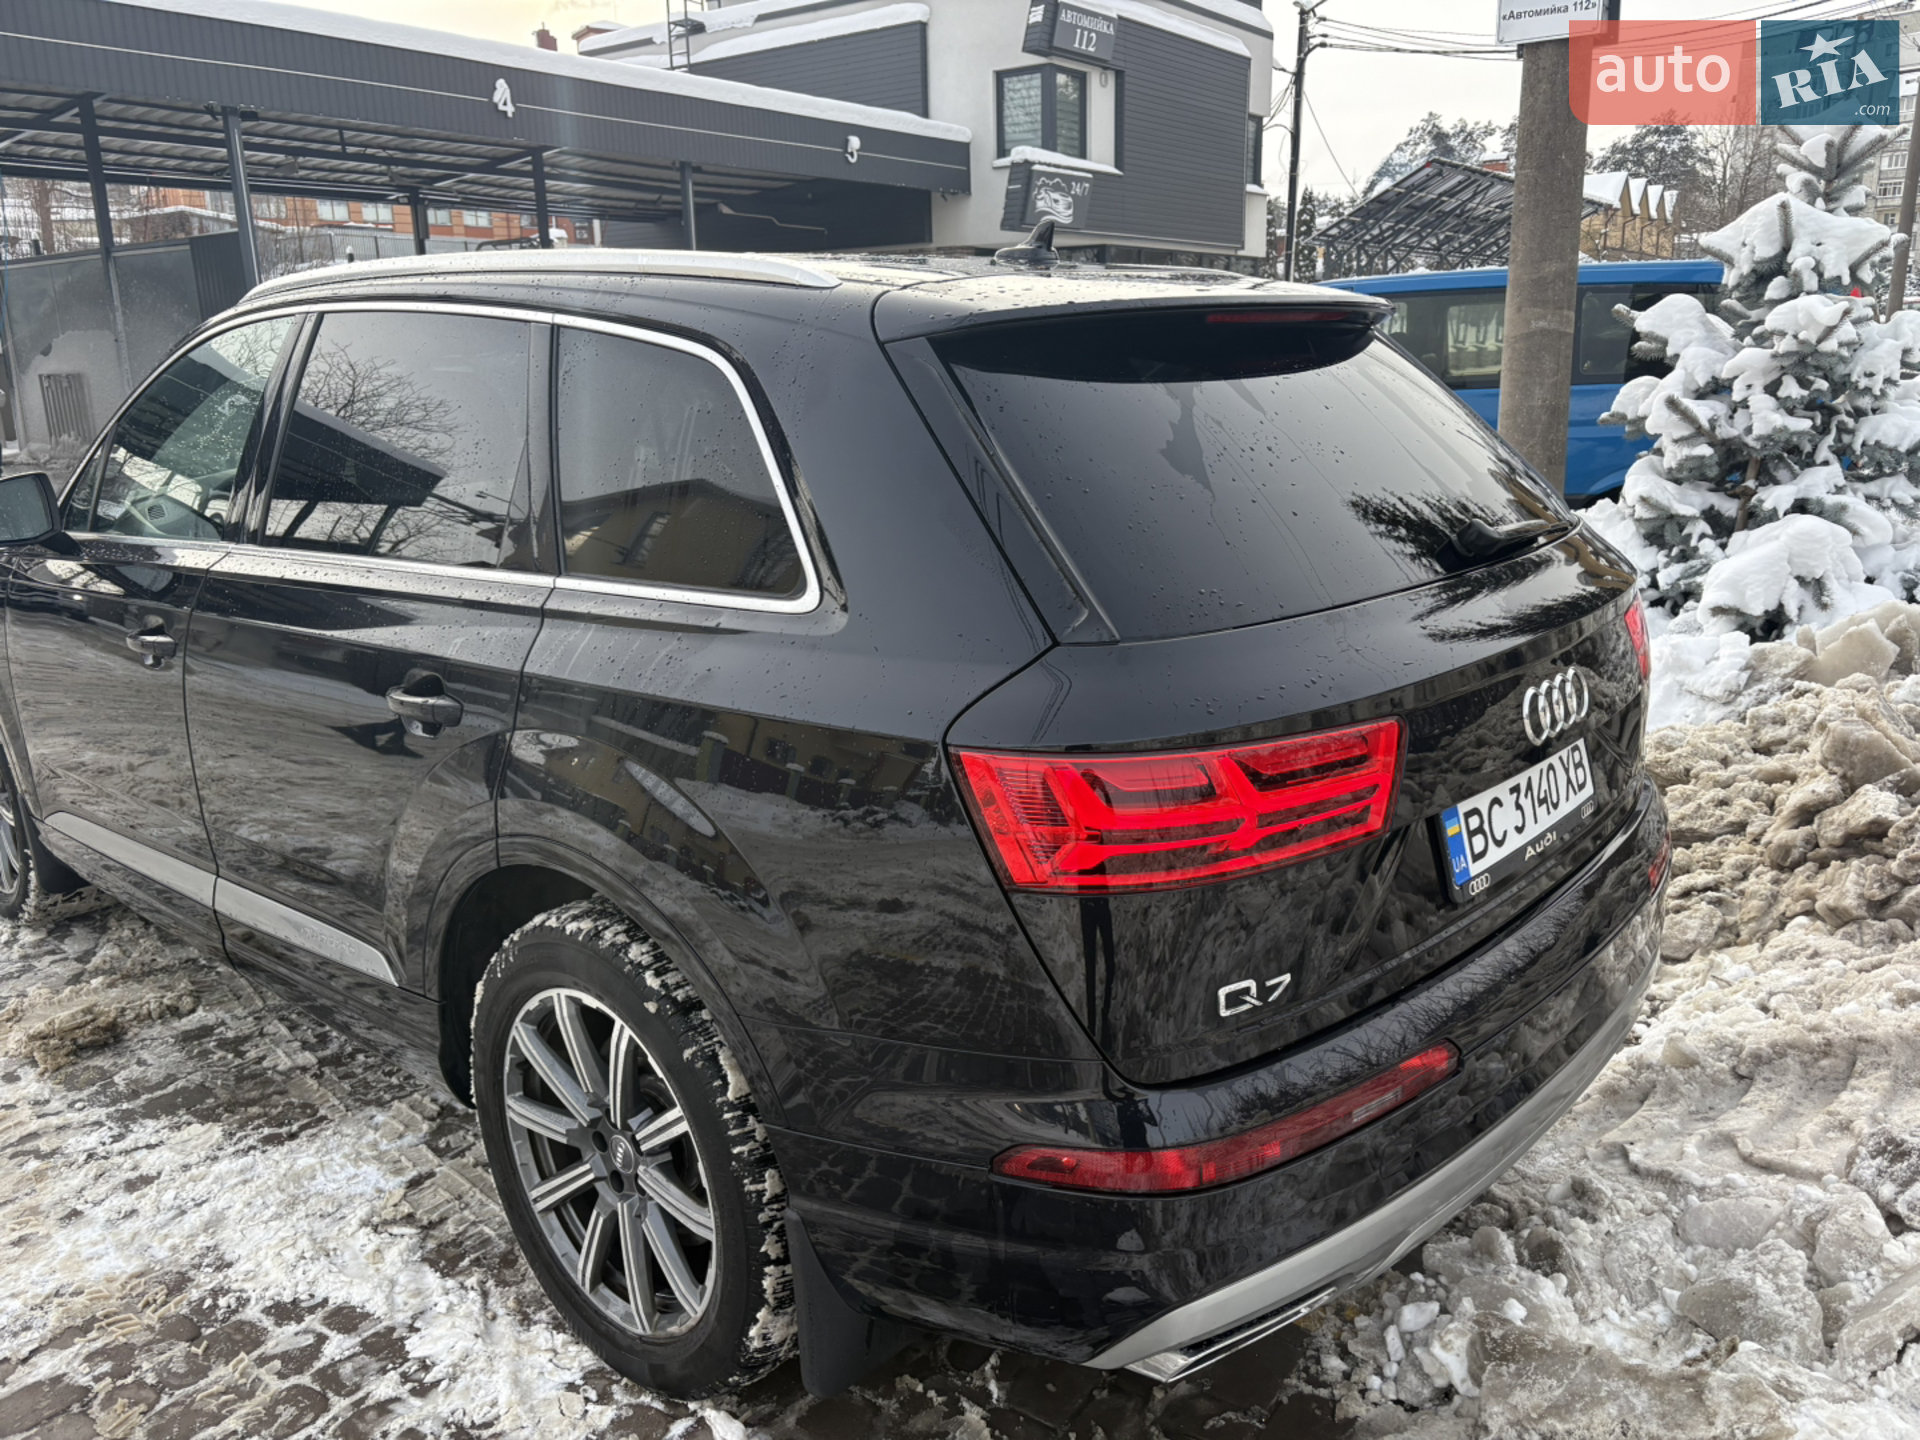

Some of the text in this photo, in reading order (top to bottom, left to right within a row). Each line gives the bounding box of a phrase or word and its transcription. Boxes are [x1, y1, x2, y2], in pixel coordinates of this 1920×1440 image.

[1060, 8, 1115, 36] АВТОМИЙКА
[1073, 28, 1097, 52] 112
[492, 78, 516, 118] 4
[1070, 181, 1090, 196] 24/7
[1463, 743, 1588, 864] BC 3140 XB
[1524, 830, 1558, 862] Audi
[1452, 854, 1468, 873] UA
[1217, 972, 1292, 1018] Q7
